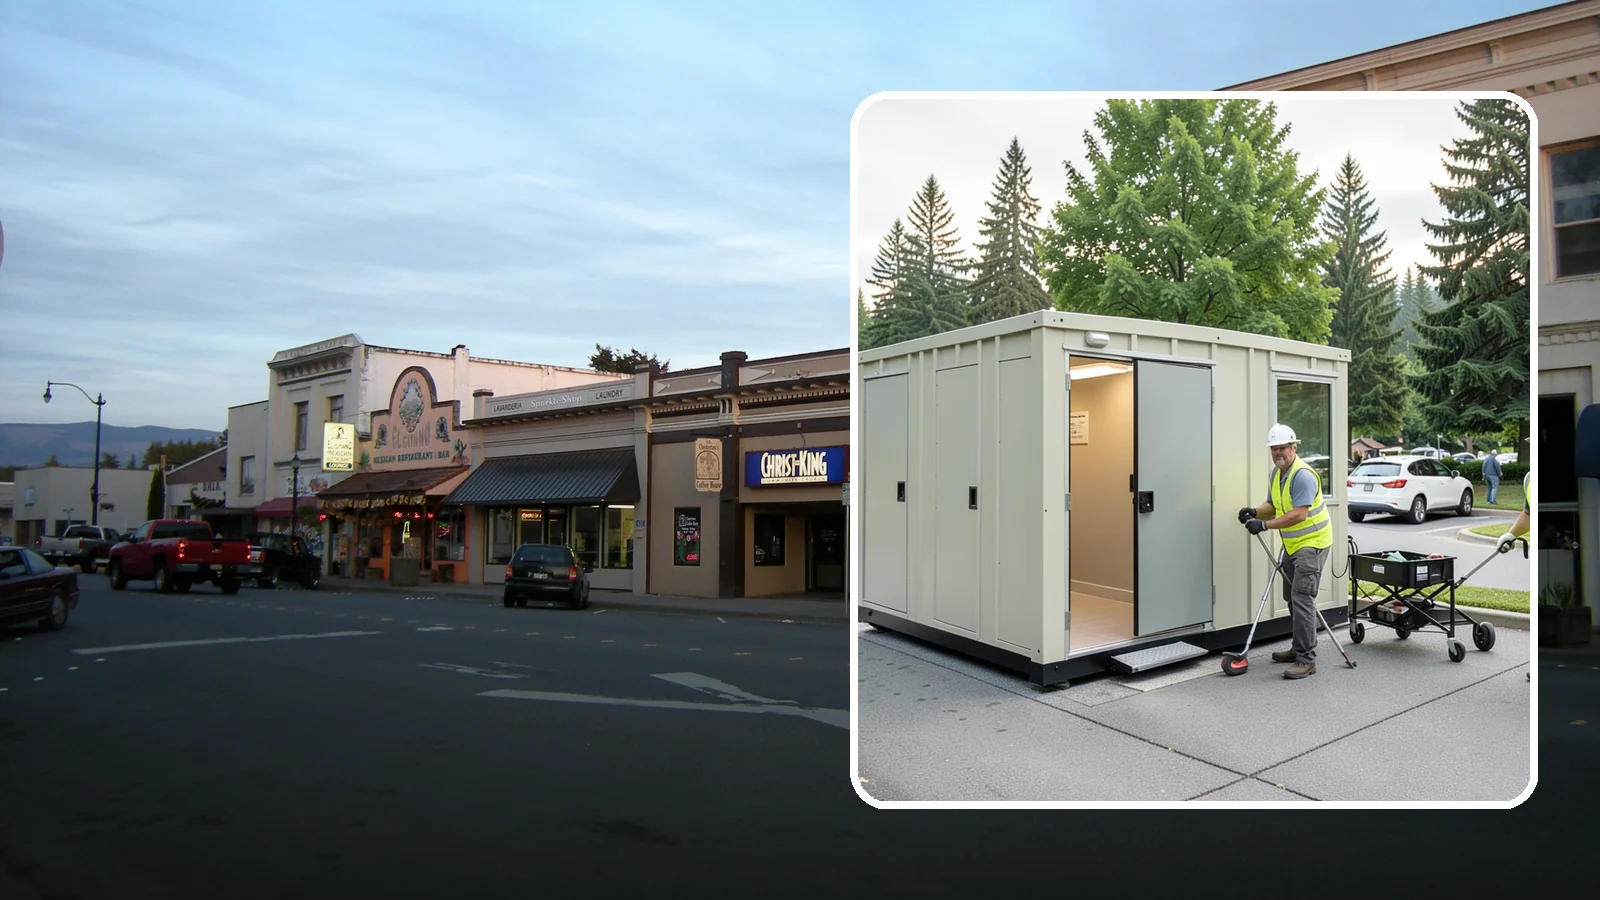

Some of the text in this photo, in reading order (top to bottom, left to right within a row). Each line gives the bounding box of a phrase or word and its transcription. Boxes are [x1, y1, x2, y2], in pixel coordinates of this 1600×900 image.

[530, 394, 582, 408] Sparkle Shop
[595, 389, 624, 400] LAUNDRY
[493, 402, 522, 413] LAVANDERIA
[373, 455, 396, 464] MEXICAN
[397, 451, 433, 462] RESTAURANT
[438, 450, 450, 459] BAR
[761, 450, 827, 478] CHRIST KING
